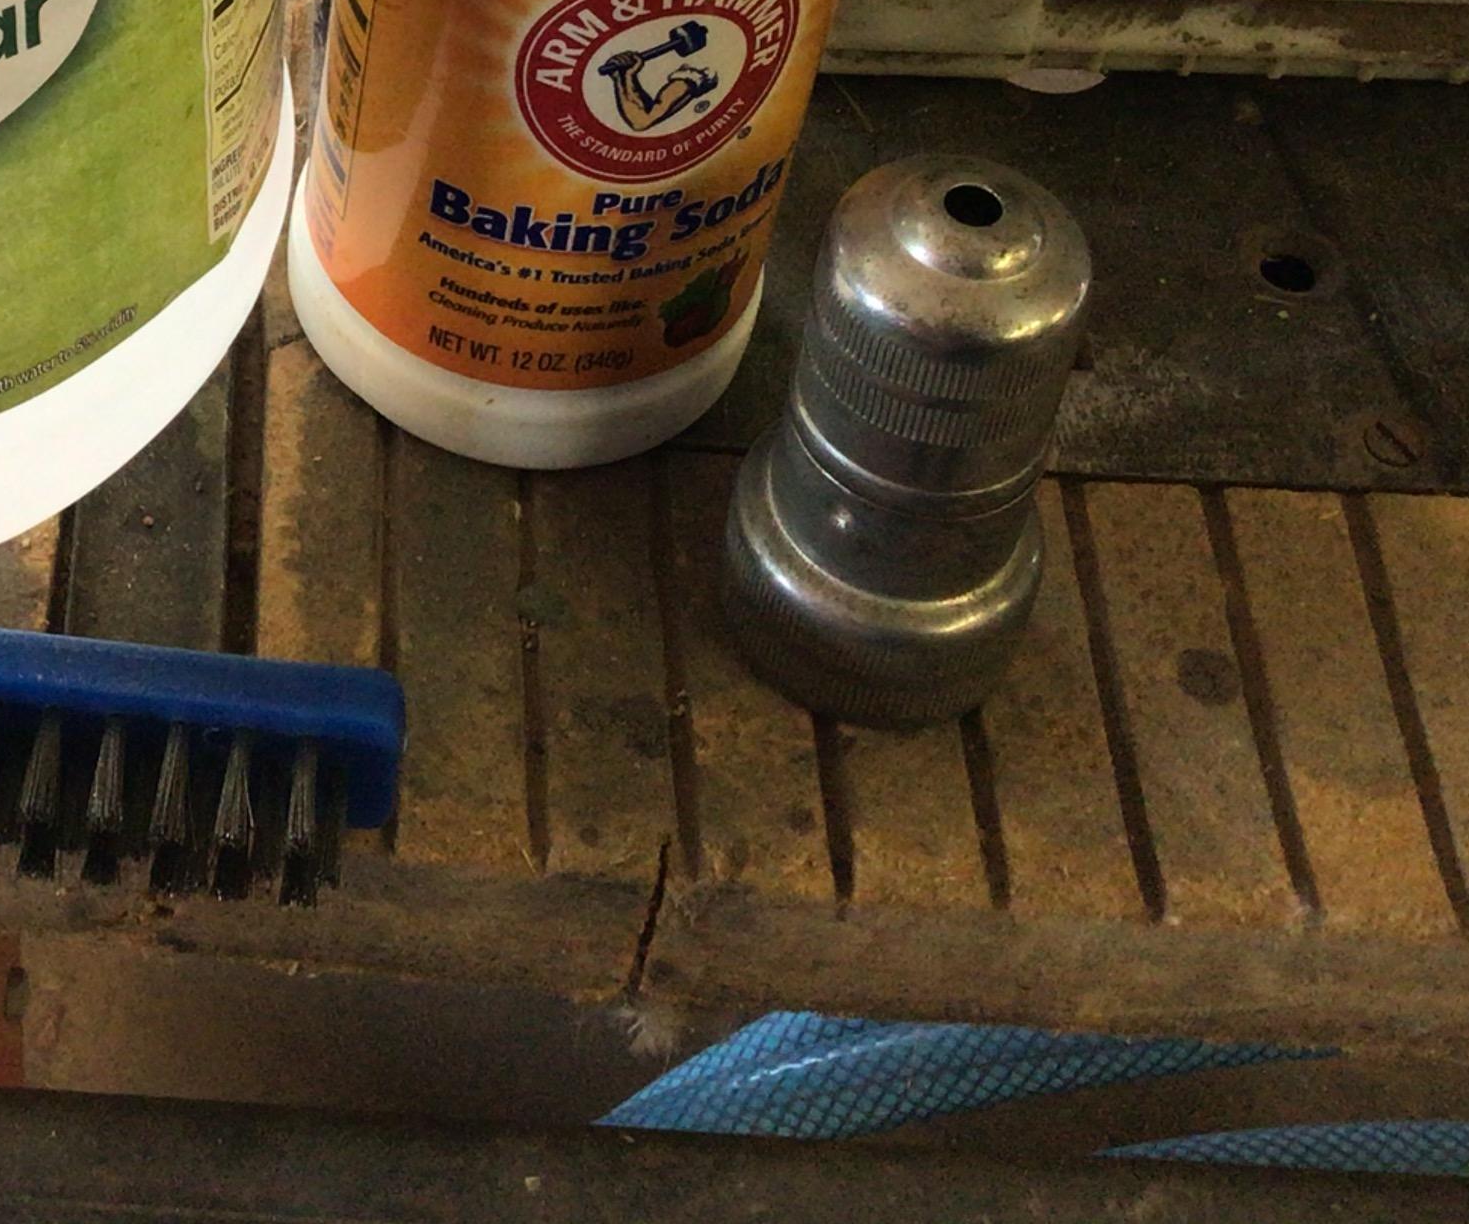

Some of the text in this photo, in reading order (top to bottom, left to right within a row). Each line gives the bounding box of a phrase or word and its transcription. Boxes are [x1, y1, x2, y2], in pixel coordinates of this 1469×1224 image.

[535, 7, 610, 94] ARM
[556, 97, 748, 163] THE STANDARD OF PURITY
[428, 178, 655, 262] Baking
[670, 158, 785, 243] Soda
[592, 187, 684, 216] Pure
[418, 230, 512, 277] America's
[517, 266, 543, 283] #1
[550, 268, 625, 285] Trusted
[628, 254, 691, 282] Baking
[427, 288, 499, 327] Cleaning
[502, 314, 571, 334] Produce
[438, 276, 532, 315] Hundreds
[535, 302, 559, 318] of
[560, 304, 604, 317] uses
[15, 357, 58, 387] water
[58, 347, 76, 366] to
[428, 323, 468, 356] NET
[511, 349, 535, 371] 12
